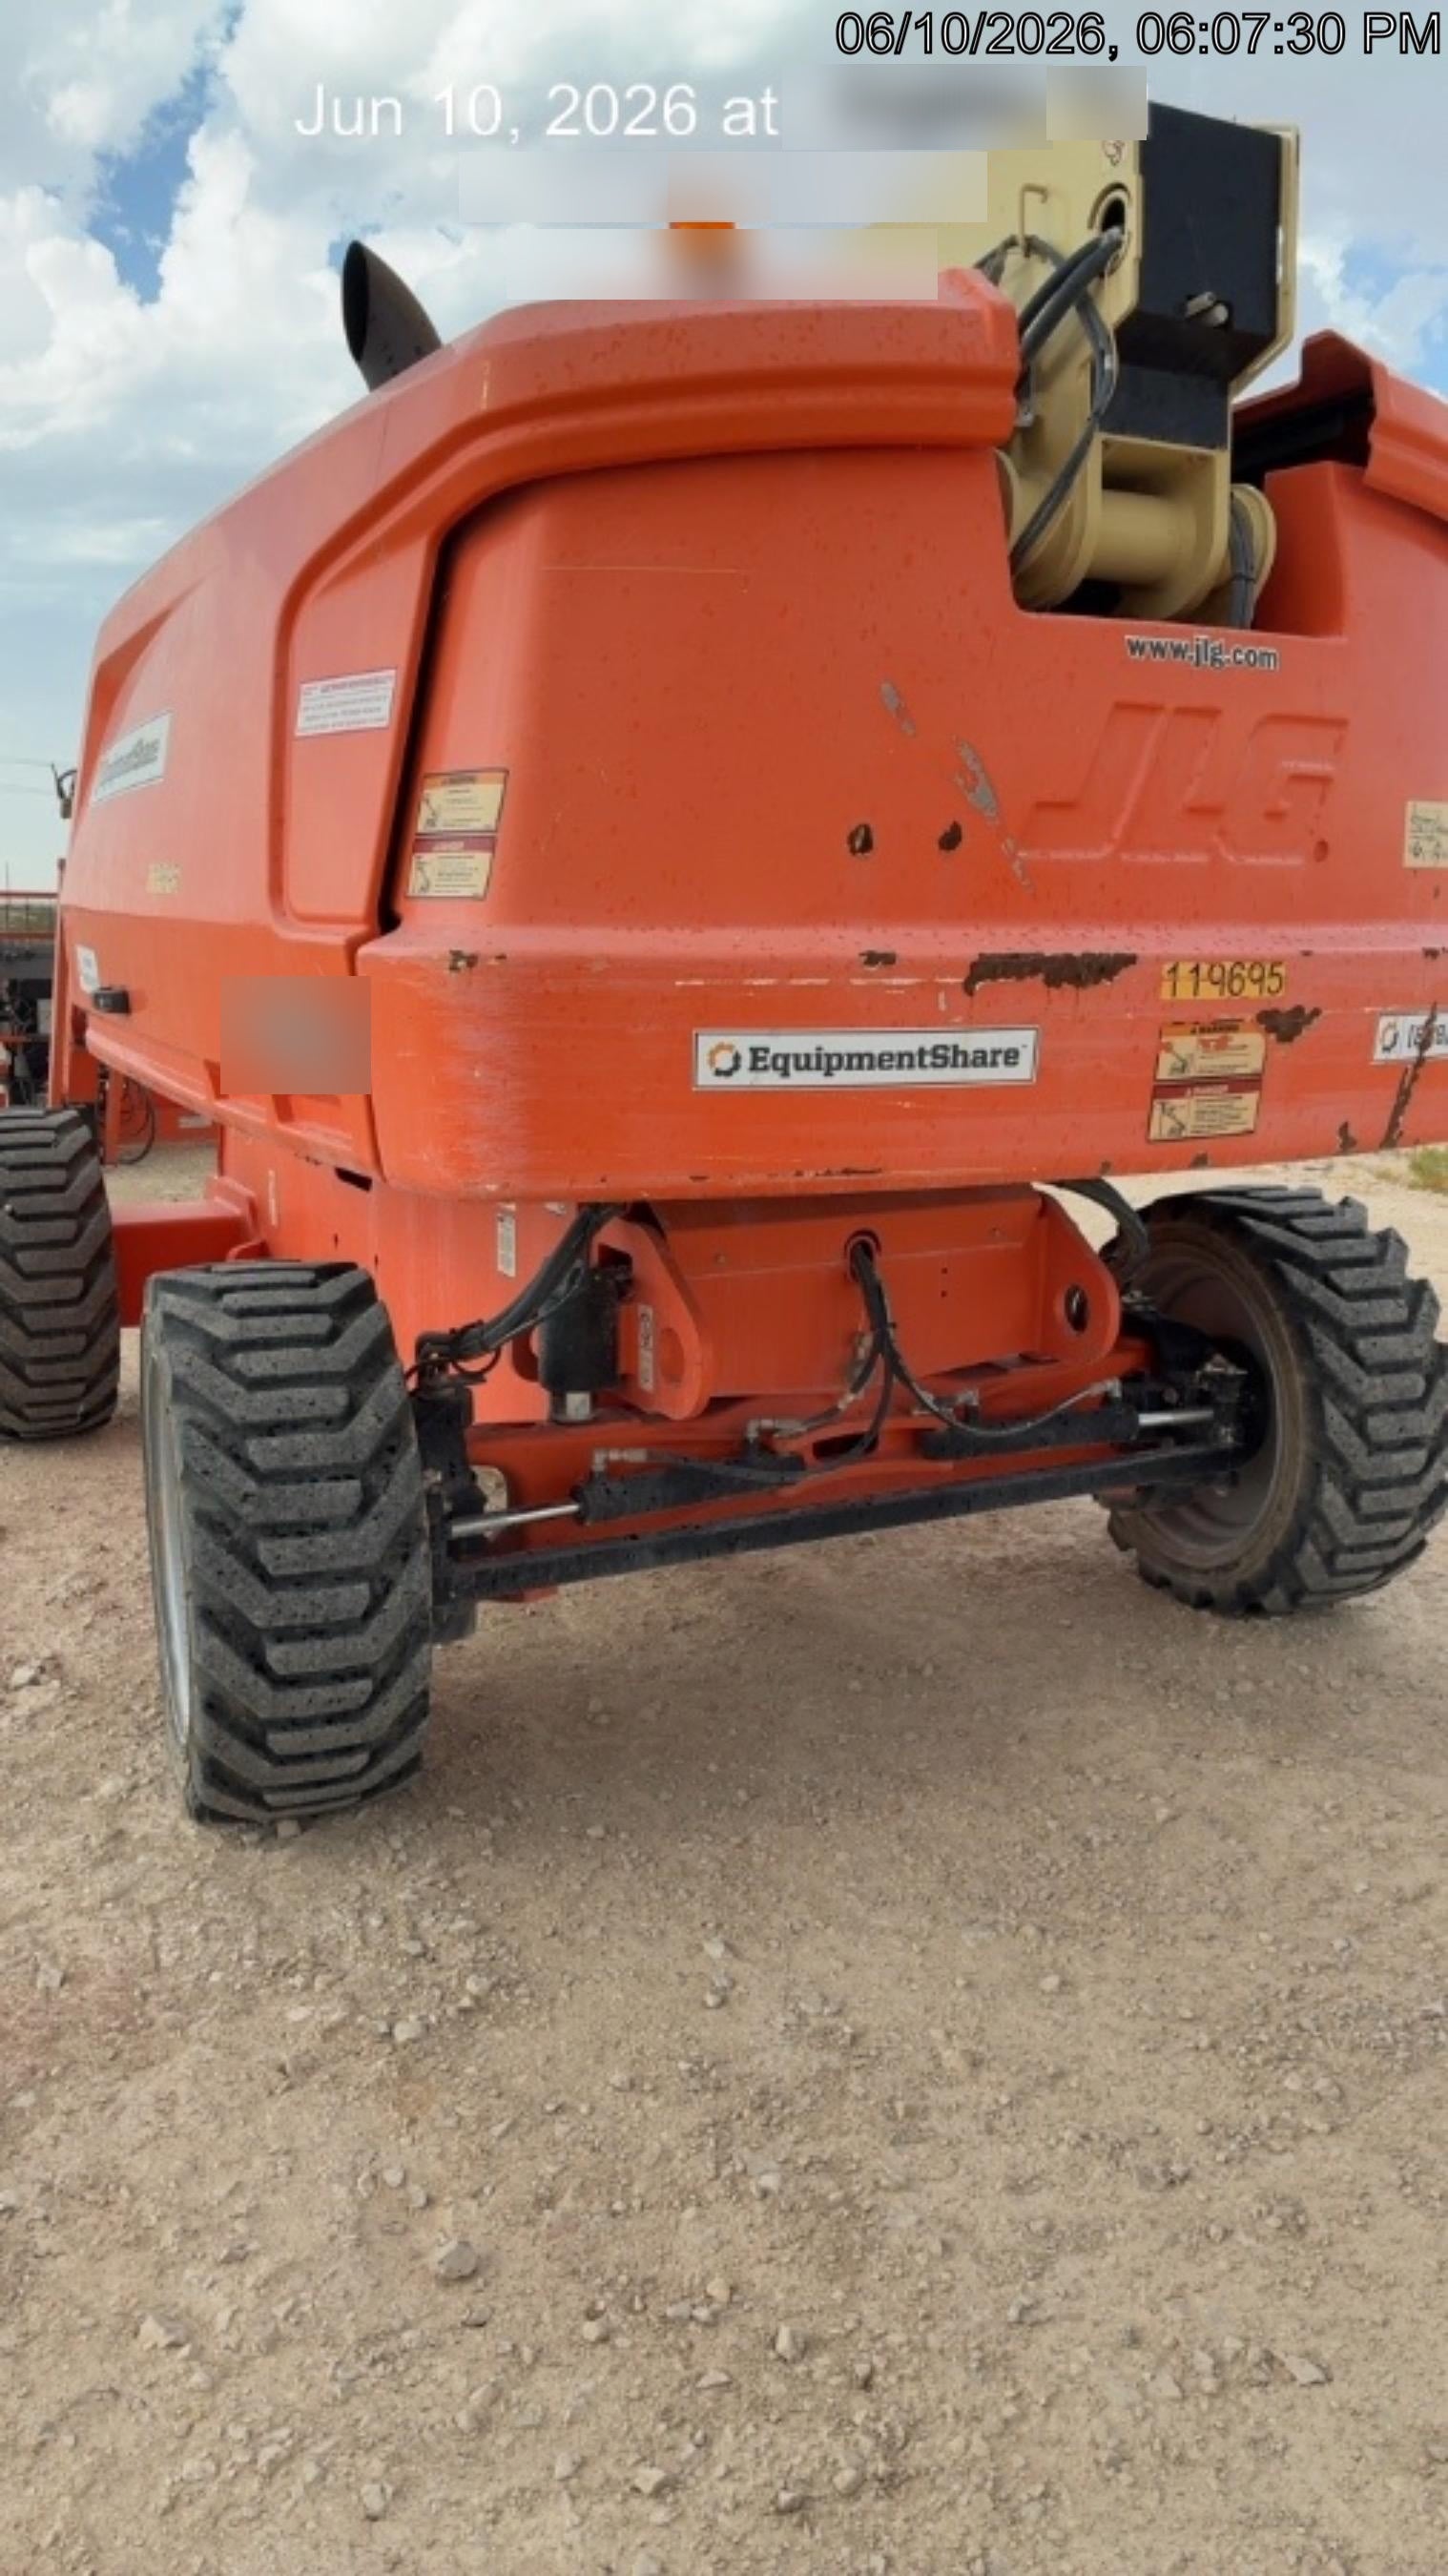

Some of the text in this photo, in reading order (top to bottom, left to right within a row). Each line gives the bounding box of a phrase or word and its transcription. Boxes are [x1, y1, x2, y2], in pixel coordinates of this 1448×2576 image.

[1127, 636, 1278, 670] www.jlg.com
[1016, 699, 1350, 865] JLG
[1166, 960, 1284, 998] 119695
[748, 1043, 1021, 1078] EquipmentShare
